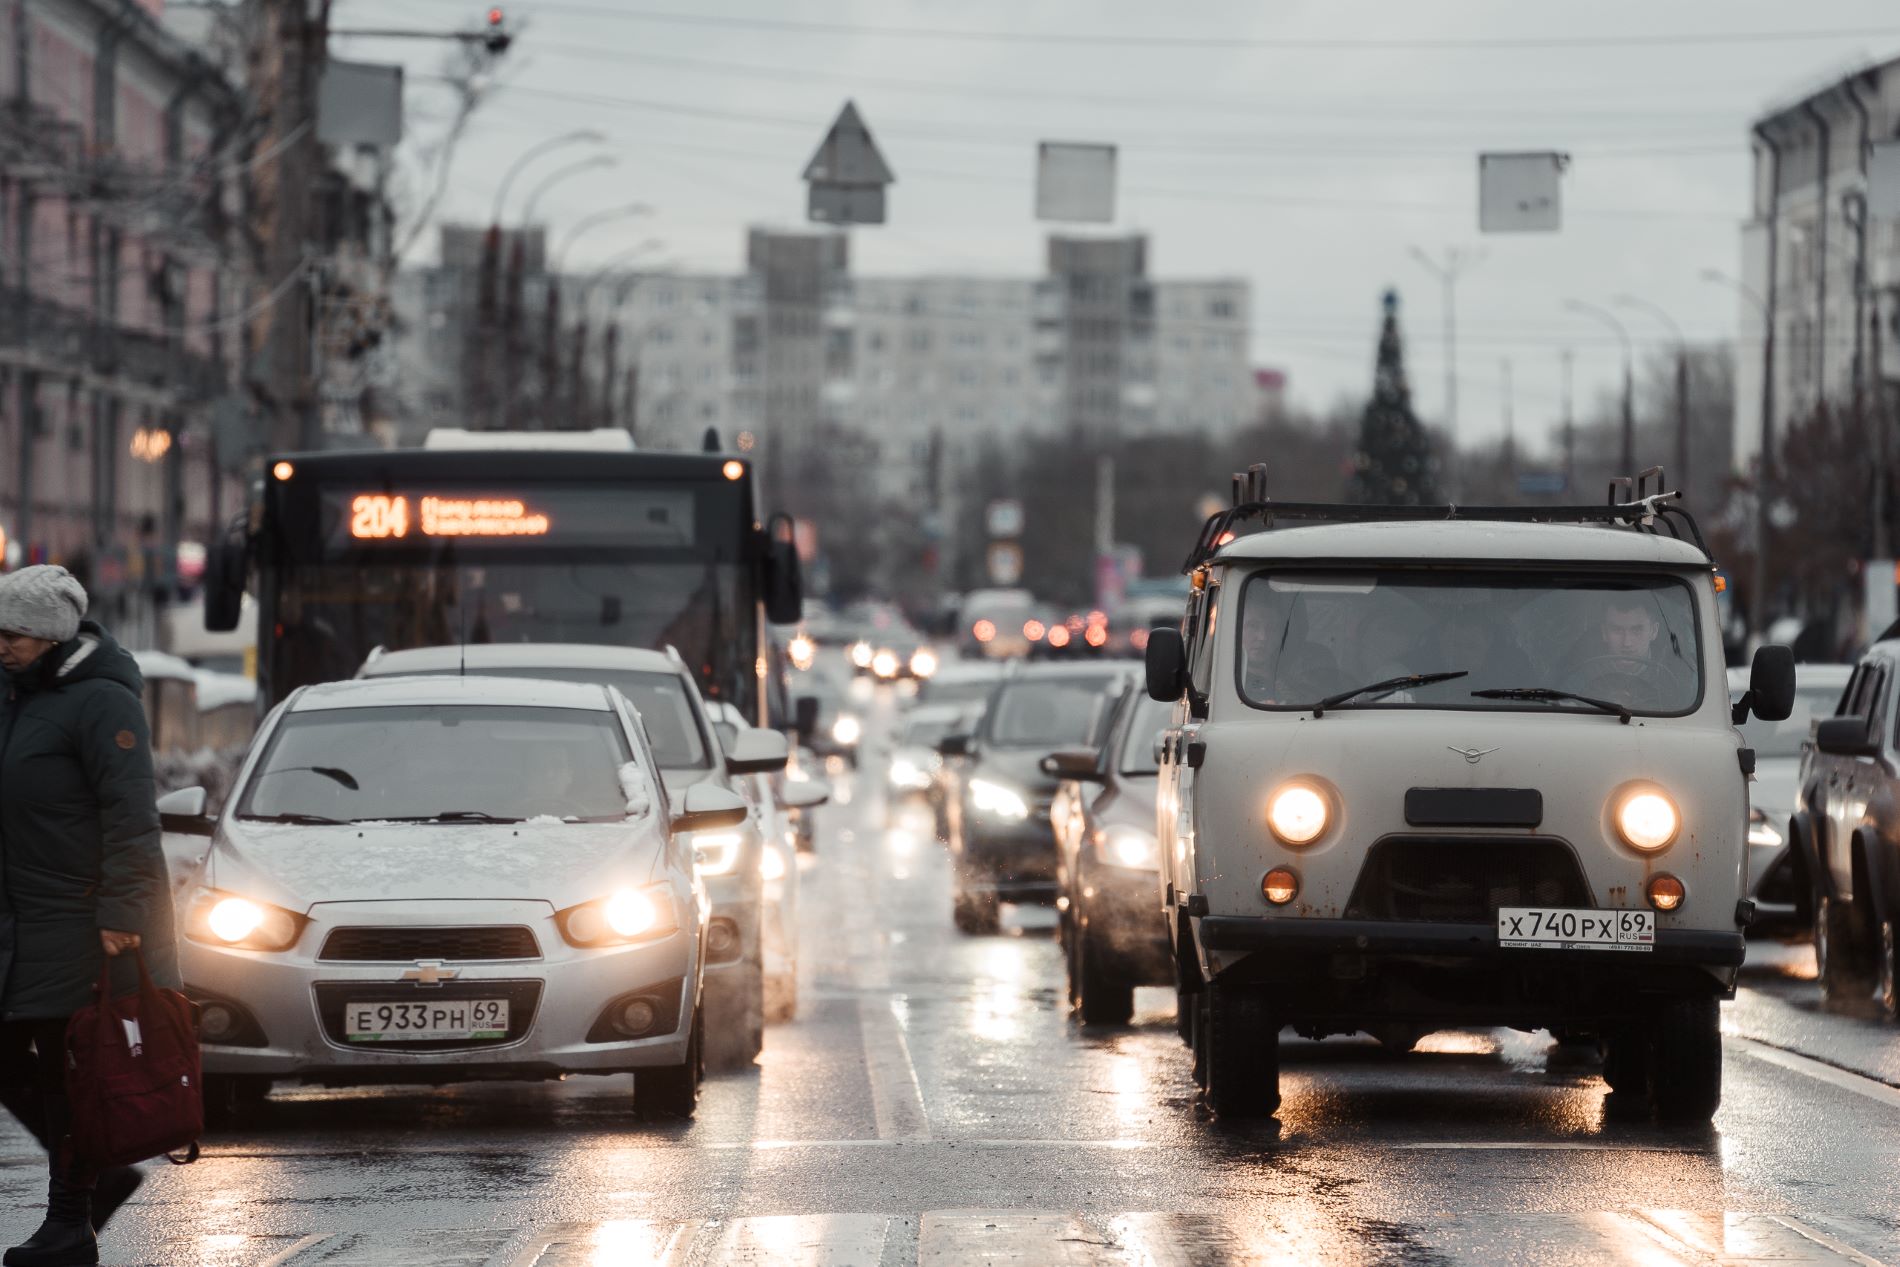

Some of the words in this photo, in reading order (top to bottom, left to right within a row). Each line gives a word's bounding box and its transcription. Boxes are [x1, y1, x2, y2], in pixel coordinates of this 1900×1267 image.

[352, 495, 407, 538] 204
[1509, 912, 1612, 939] Х740РХ
[1620, 912, 1645, 933] 69
[1619, 932, 1638, 941] RUS
[358, 1005, 464, 1031] Е933РН
[473, 1002, 499, 1021] 69
